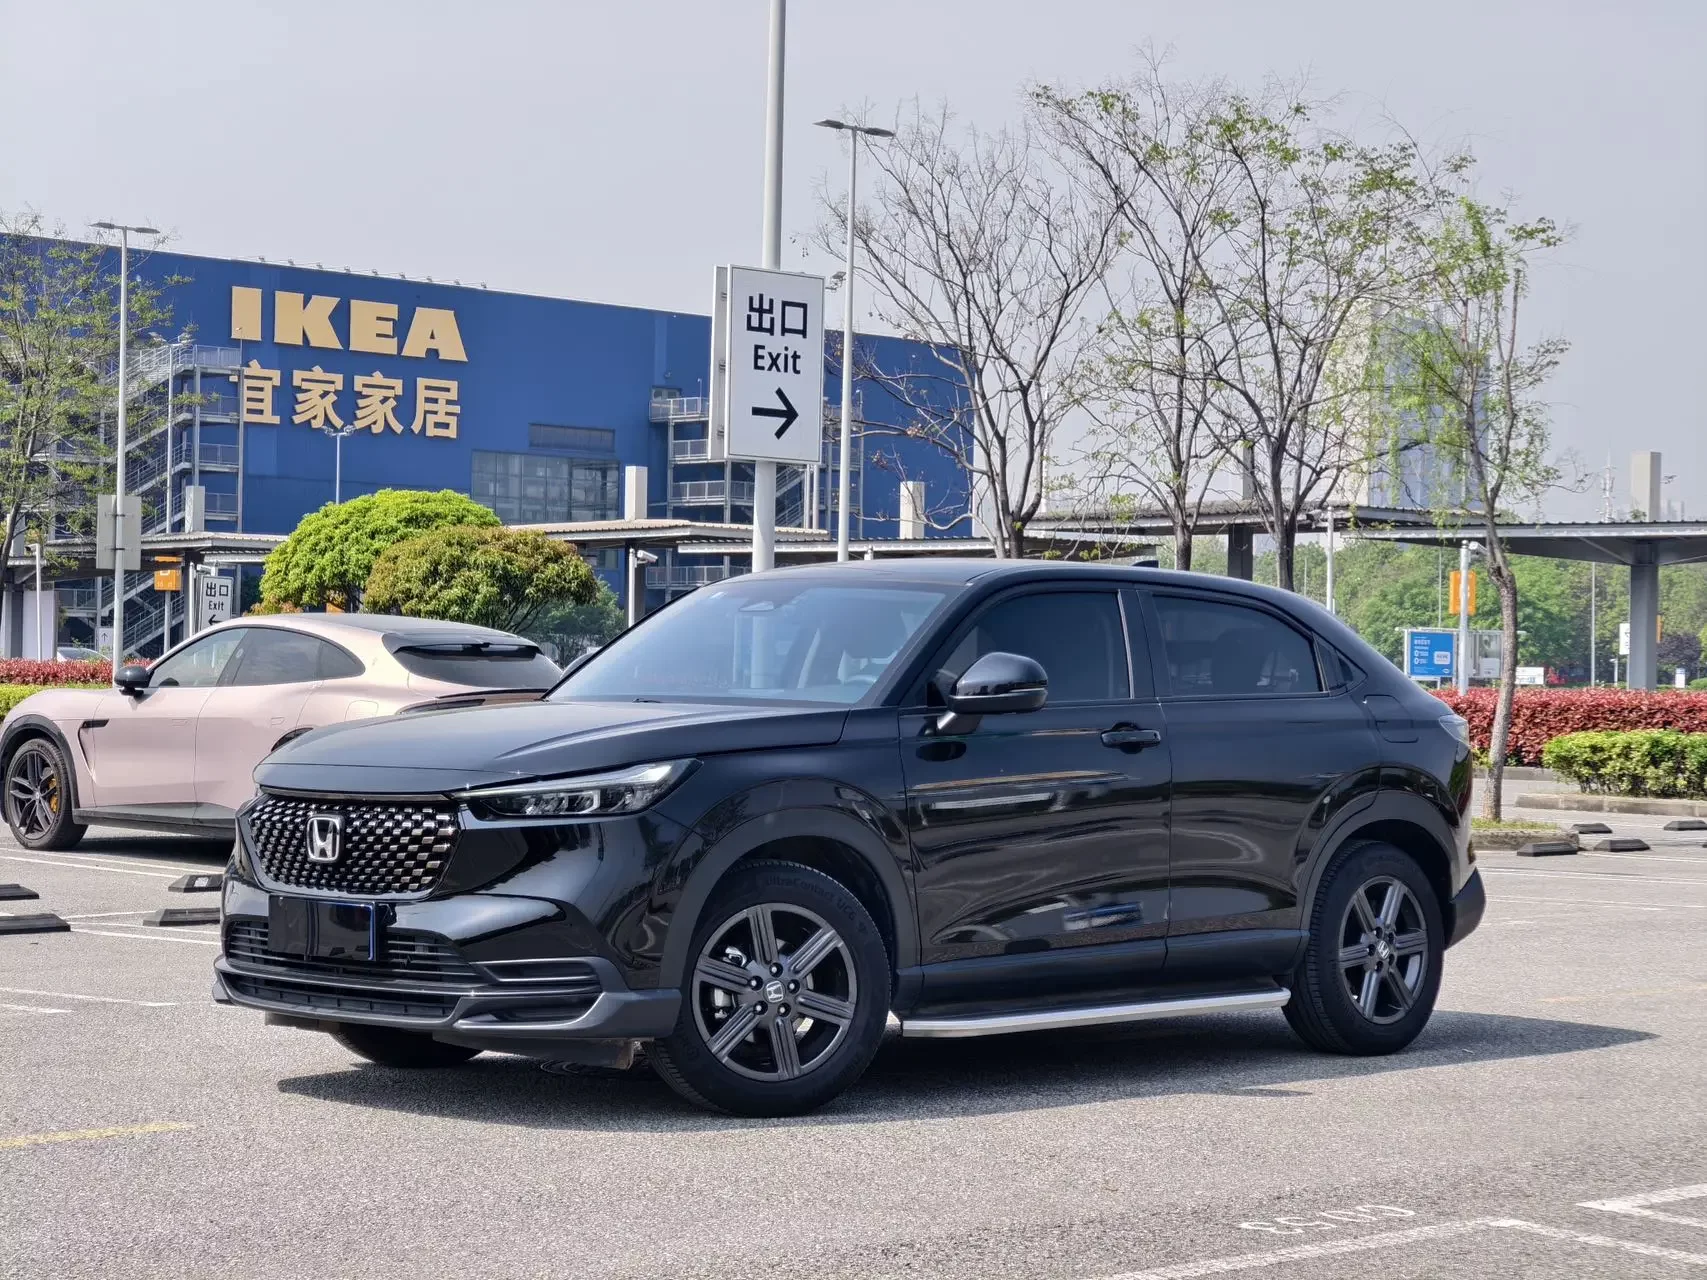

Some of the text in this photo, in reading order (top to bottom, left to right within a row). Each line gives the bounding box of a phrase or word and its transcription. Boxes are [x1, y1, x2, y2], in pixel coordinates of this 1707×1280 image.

[231, 286, 468, 361] IKEA
[746, 293, 808, 339] 出口
[754, 344, 801, 374] Exit
[229, 359, 460, 439] 宜家家居
[205, 582, 229, 597] 出口
[208, 600, 225, 611] Exit
